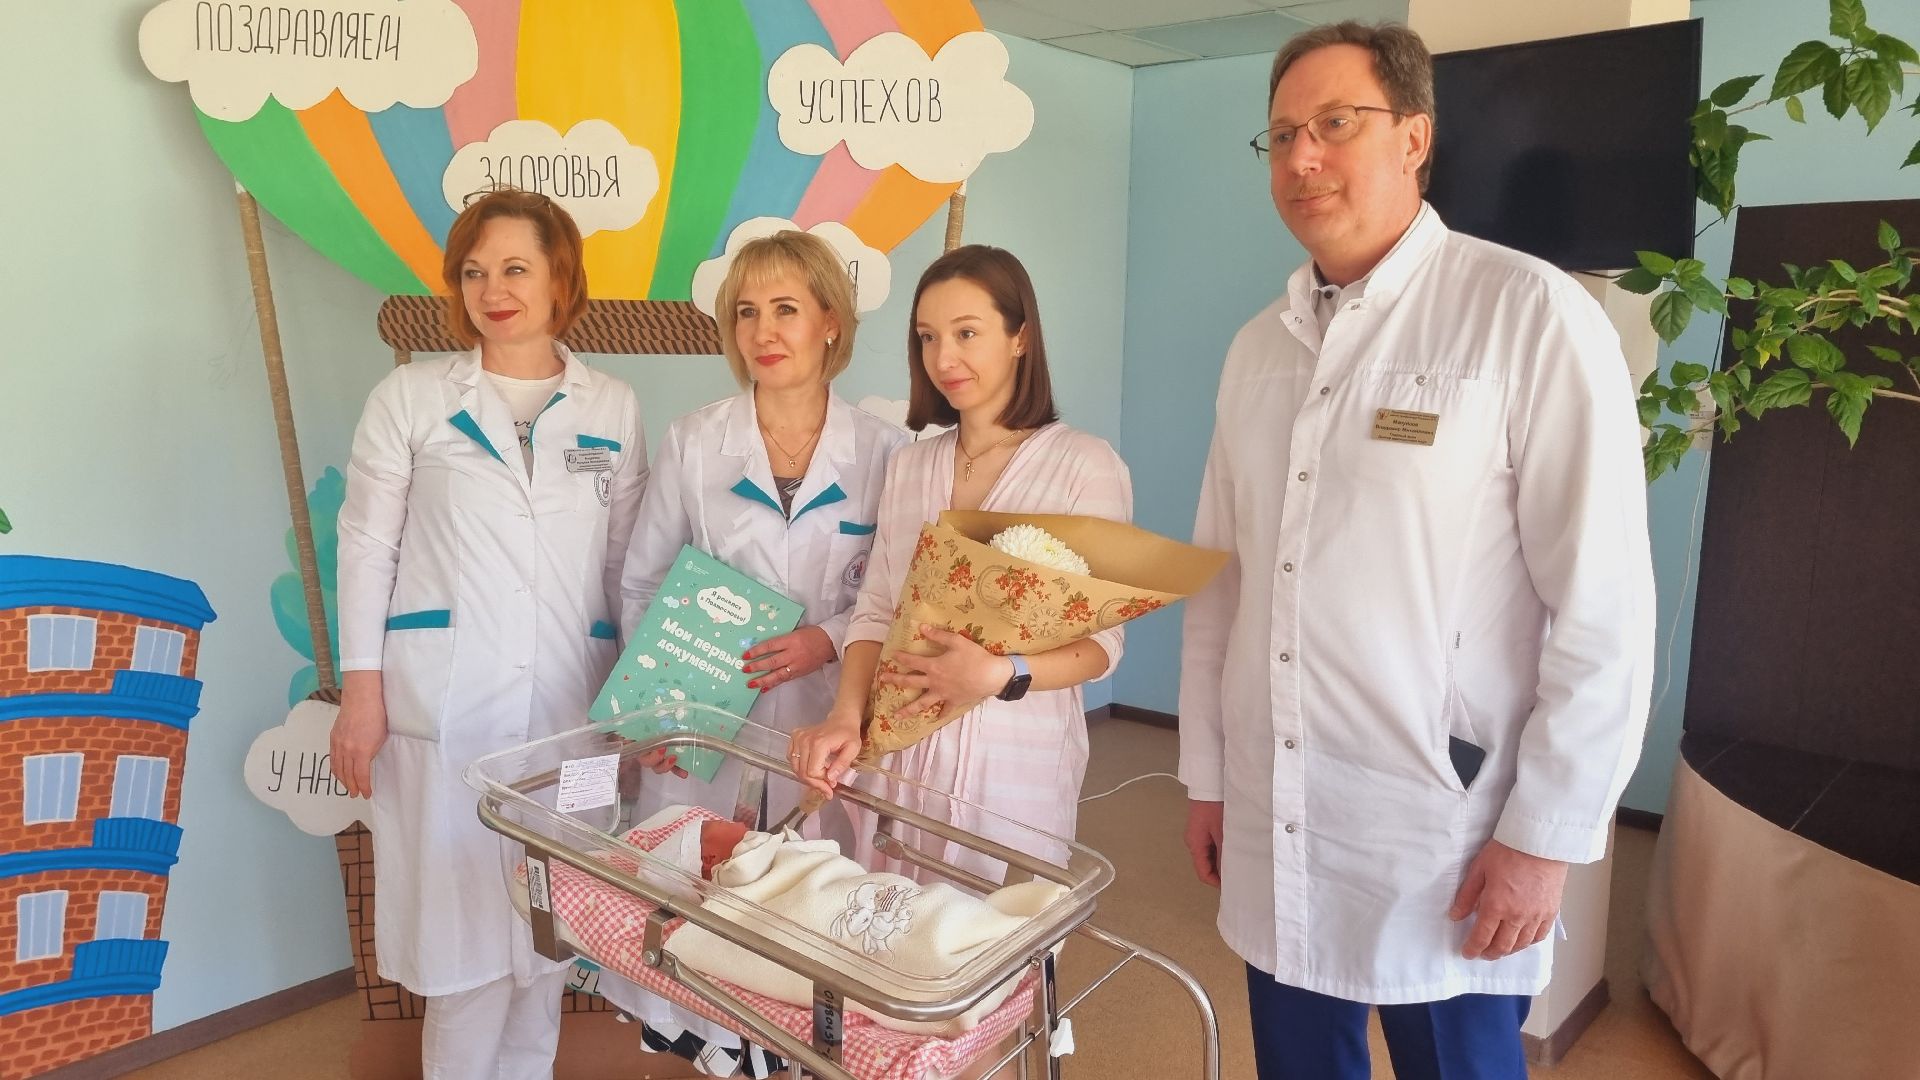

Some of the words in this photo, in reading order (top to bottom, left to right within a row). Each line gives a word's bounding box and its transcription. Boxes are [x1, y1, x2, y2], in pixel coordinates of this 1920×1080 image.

[196, 2, 401, 61] ПОЗДРАВЛЯЕМ
[798, 78, 942, 124] УСПЕХОВ
[480, 154, 620, 198] ЗДОРОВЬЯ
[657, 638, 732, 683] документы
[661, 617, 692, 642] Мои
[694, 637, 745, 670] первые
[268, 750, 286, 792] У
